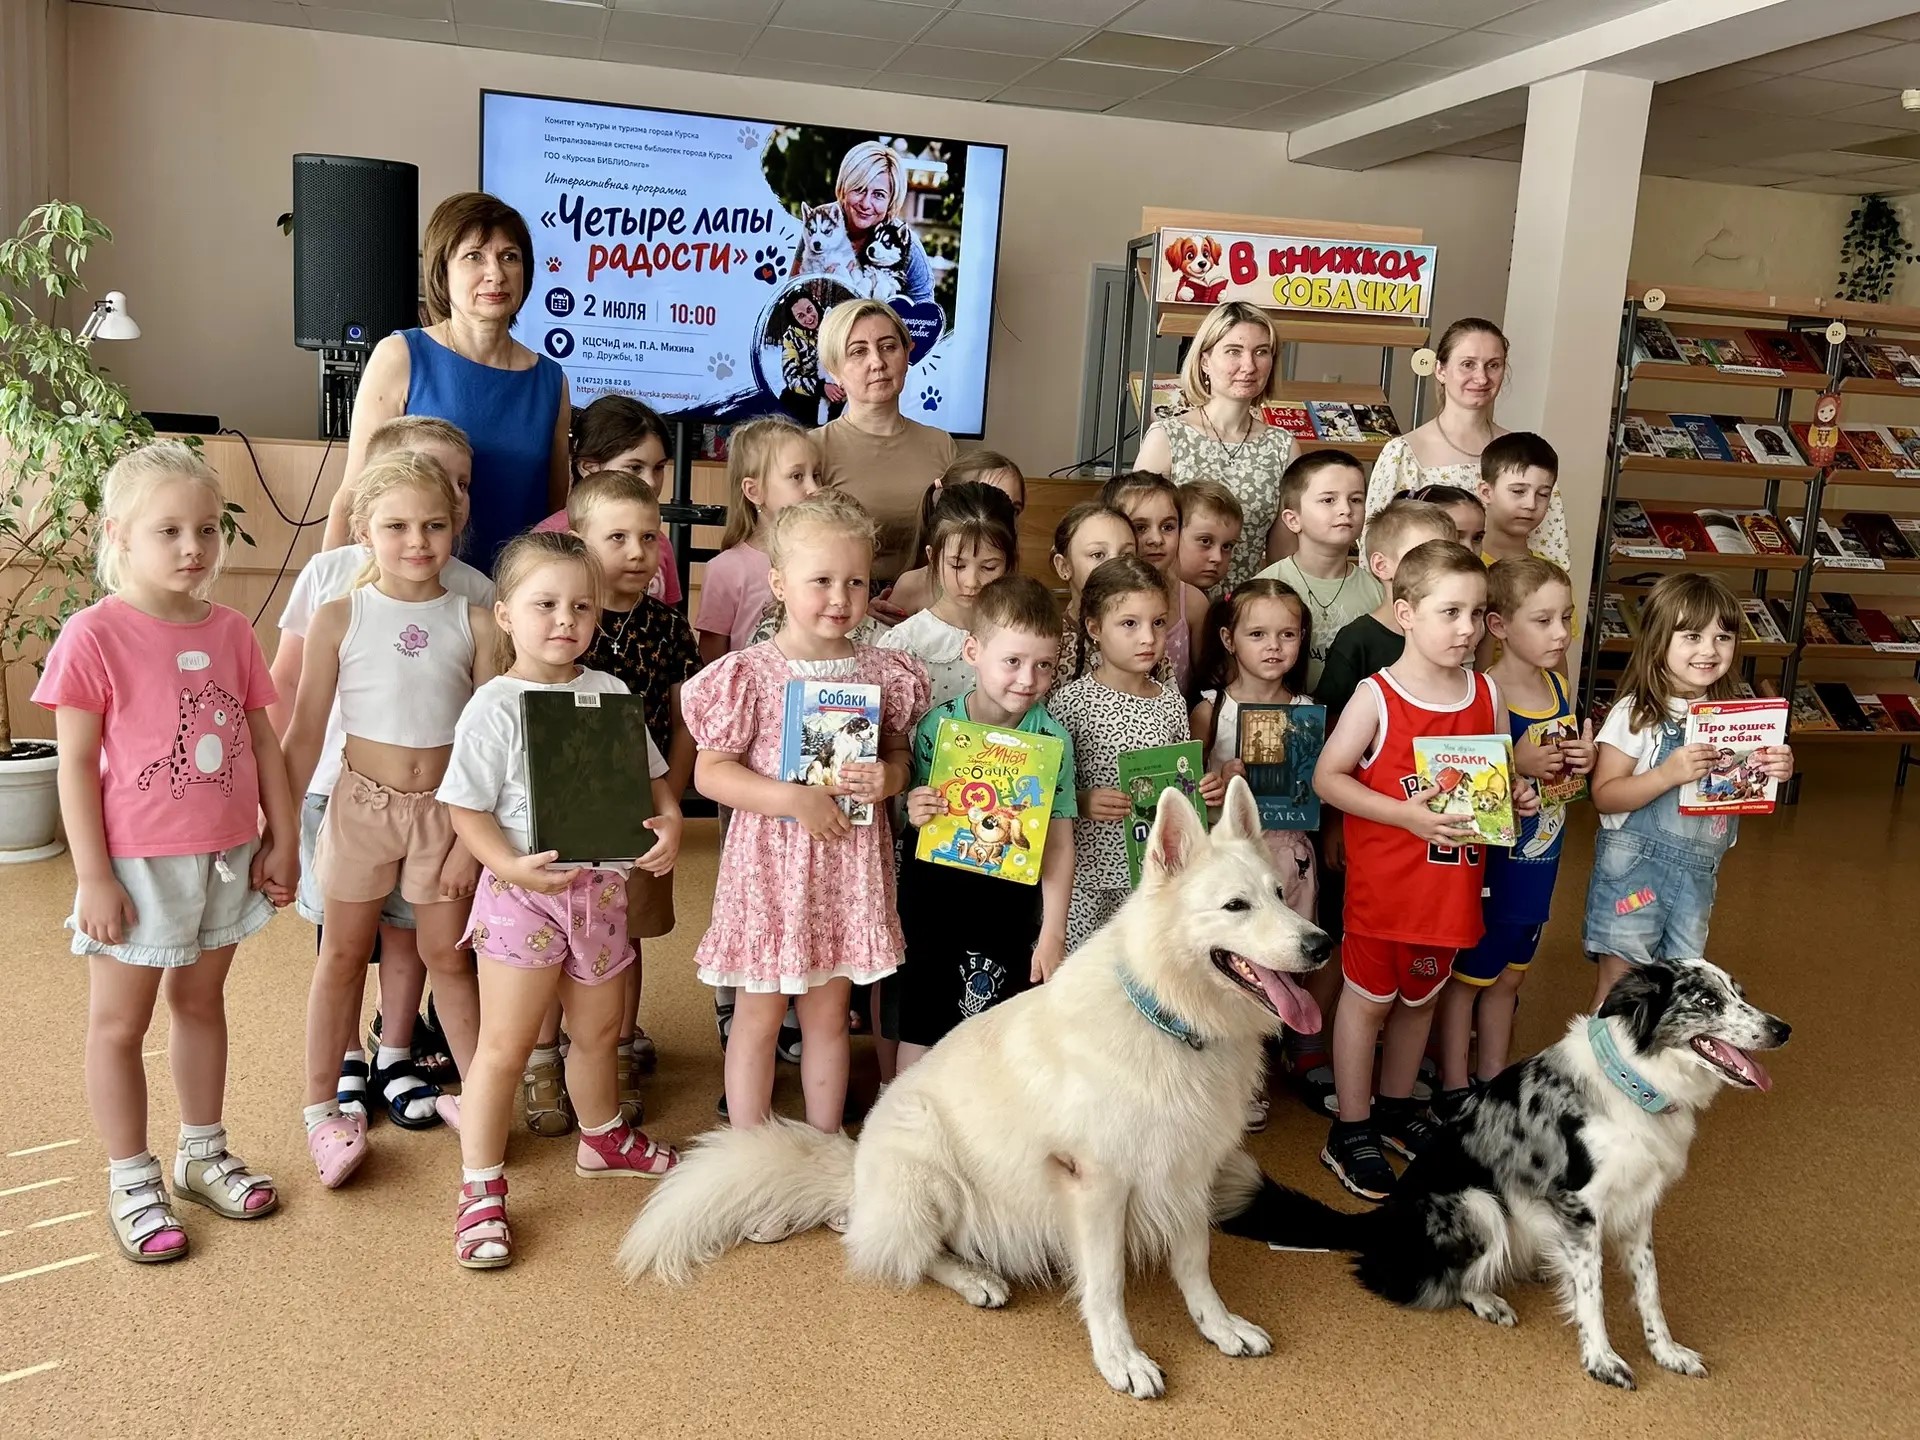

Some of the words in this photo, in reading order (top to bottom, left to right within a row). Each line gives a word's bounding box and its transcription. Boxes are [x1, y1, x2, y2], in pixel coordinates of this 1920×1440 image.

[544, 116, 575, 126] Комитет
[576, 121, 611, 131] культуры
[618, 125, 648, 134] туризма
[649, 128, 673, 138] города
[674, 130, 700, 140] Курска
[544, 134, 613, 148] Централизованная
[614, 141, 643, 151] система
[644, 144, 682, 155] библиотек
[682, 149, 707, 159] города
[708, 151, 733, 161] Курска
[544, 151, 561, 160] ГОО
[562, 153, 596, 165] «Курская
[544, 171, 629, 191] Интерактивная
[631, 183, 688, 197] программа
[540, 192, 687, 243] «Четыре
[692, 206, 774, 236] лапы
[587, 242, 748, 283] радости»
[1228, 240, 1260, 286] В
[1272, 275, 1422, 314] СОБАЧКИ
[583, 293, 597, 317] 2
[670, 302, 717, 327] 10:00
[582, 336, 621, 350] КЦСЧиД
[622, 341, 637, 351] им.
[639, 340, 659, 352] П.А.
[660, 342, 695, 354] Михина
[582, 352, 595, 361] пр.
[597, 352, 633, 363] Дружбы,
[635, 353, 644, 363] 18
[582, 376, 604, 386] (4712)
[604, 378, 613, 386] 58
[1270, 407, 1293, 418] Как
[1274, 416, 1305, 427] быть
[818, 688, 867, 707] Собаки
[1698, 722, 1726, 734] Про
[1729, 722, 1776, 731] кошек
[1722, 731, 1762, 743] собак
[976, 738, 1028, 766] Умная
[1434, 753, 1487, 766] СОБАКИ
[954, 765, 1019, 781] собачка
[1409, 956, 1438, 976] 23
